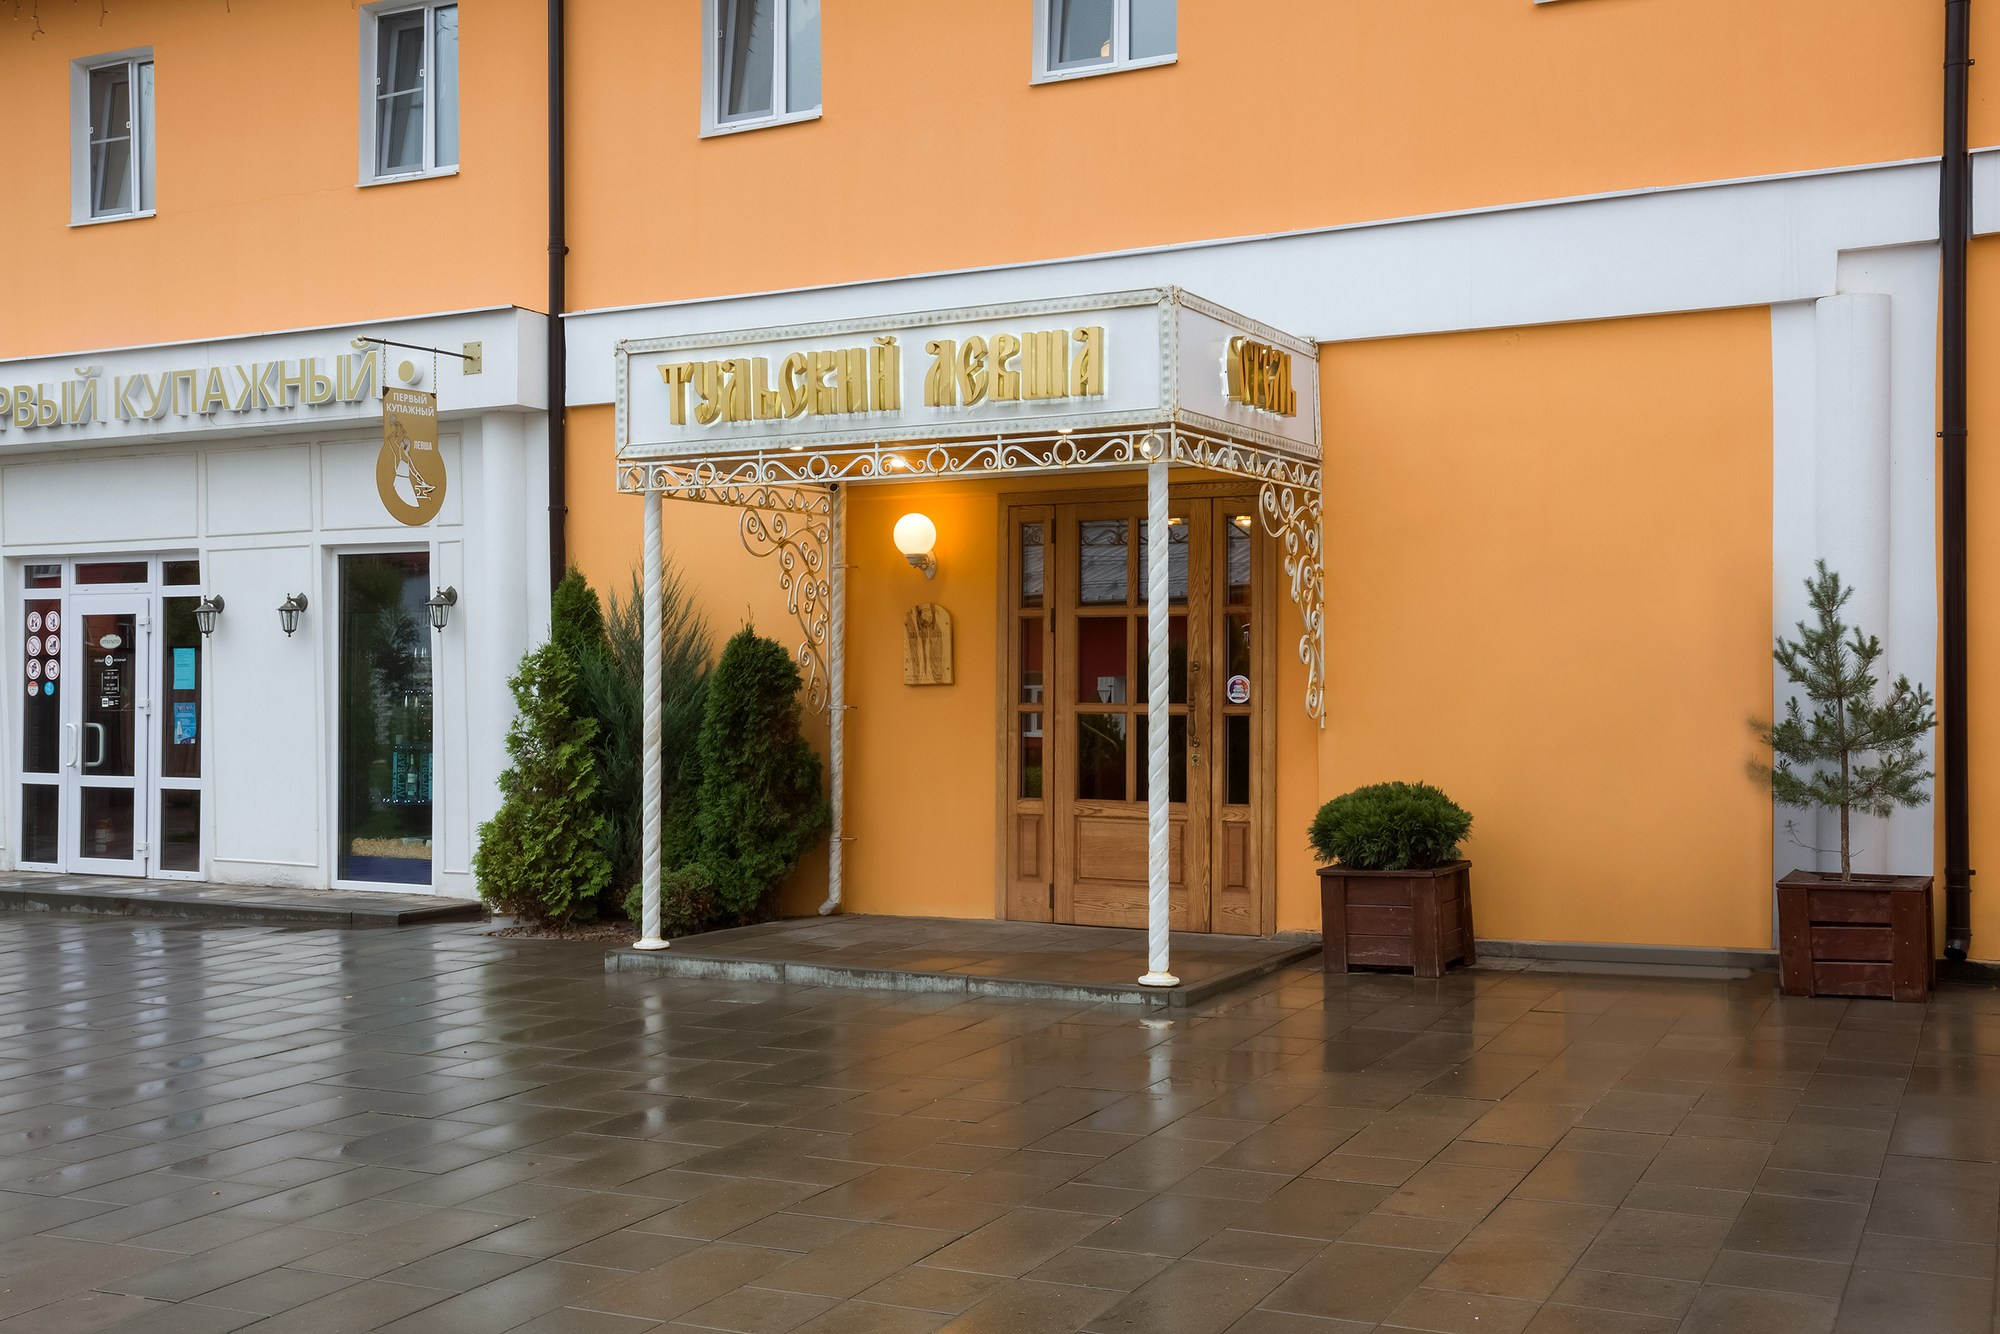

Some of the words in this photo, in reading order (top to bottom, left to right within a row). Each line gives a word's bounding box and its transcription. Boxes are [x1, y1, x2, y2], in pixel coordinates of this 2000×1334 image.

[114, 339, 380, 421] КУПАЖНЫЙ
[657, 336, 901, 426] ТУЛЬСКИЙ
[924, 326, 1105, 407] ЛЕВША
[393, 392, 428, 405] ПЕРВЫЙ
[386, 403, 435, 417] КУПАЖНЫЙ
[413, 440, 433, 451] ЛЕВША
